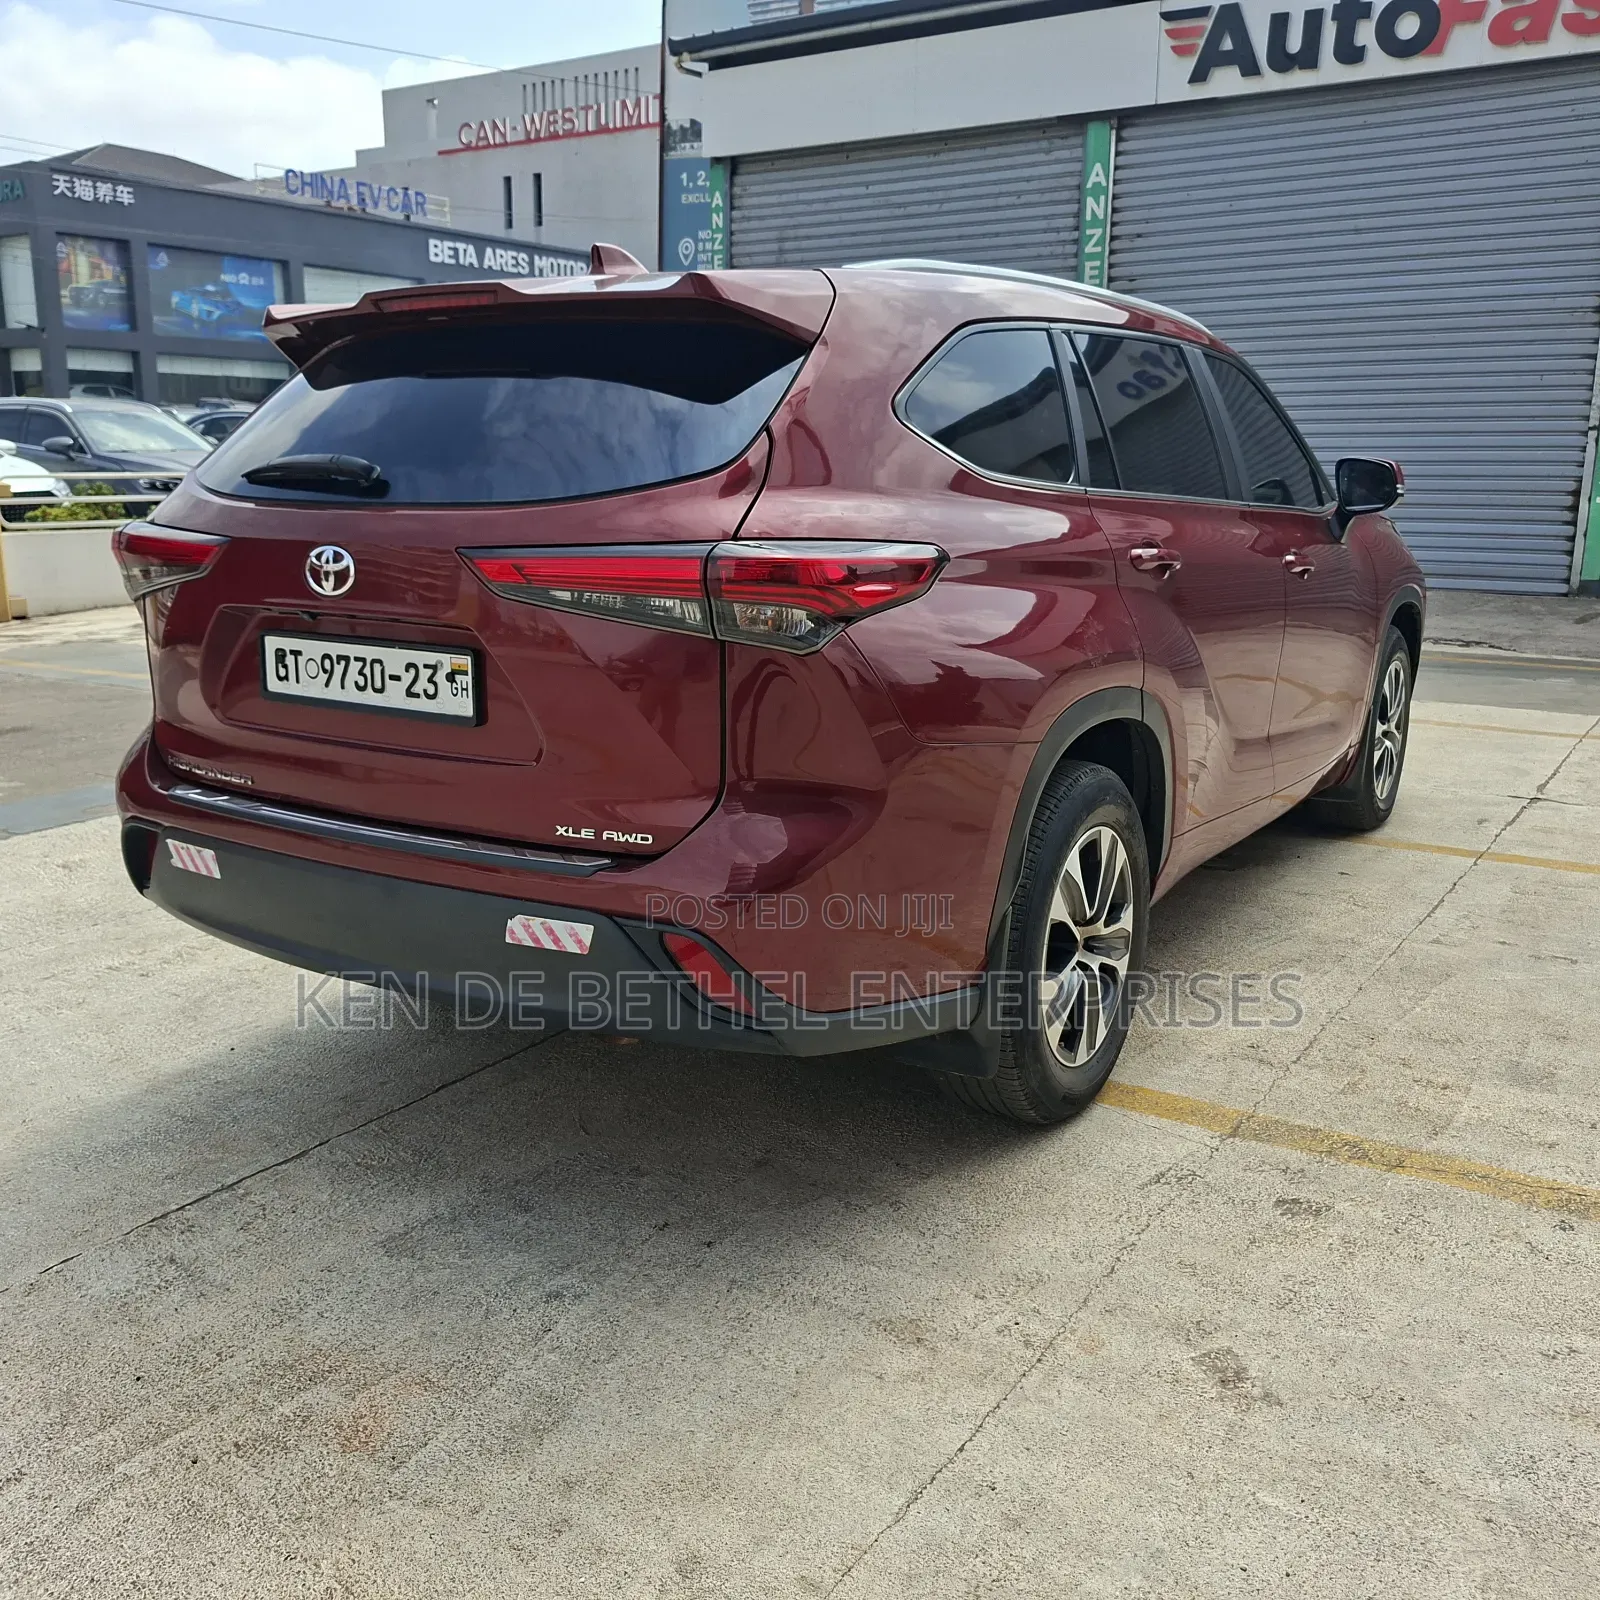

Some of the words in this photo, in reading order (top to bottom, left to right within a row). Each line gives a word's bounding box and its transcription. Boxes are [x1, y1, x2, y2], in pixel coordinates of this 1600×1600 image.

[51, 173, 136, 206] 天猫养车
[284, 168, 350, 205] CHINA
[356, 181, 382, 210] EV
[386, 186, 428, 217] CAR
[428, 238, 479, 268] BETA
[483, 247, 529, 275] ARES
[274, 647, 303, 684] GT
[320, 652, 439, 700] 9730-23
[450, 679, 469, 699] GH
[555, 825, 596, 840] XLE
[602, 830, 653, 845] AWD
